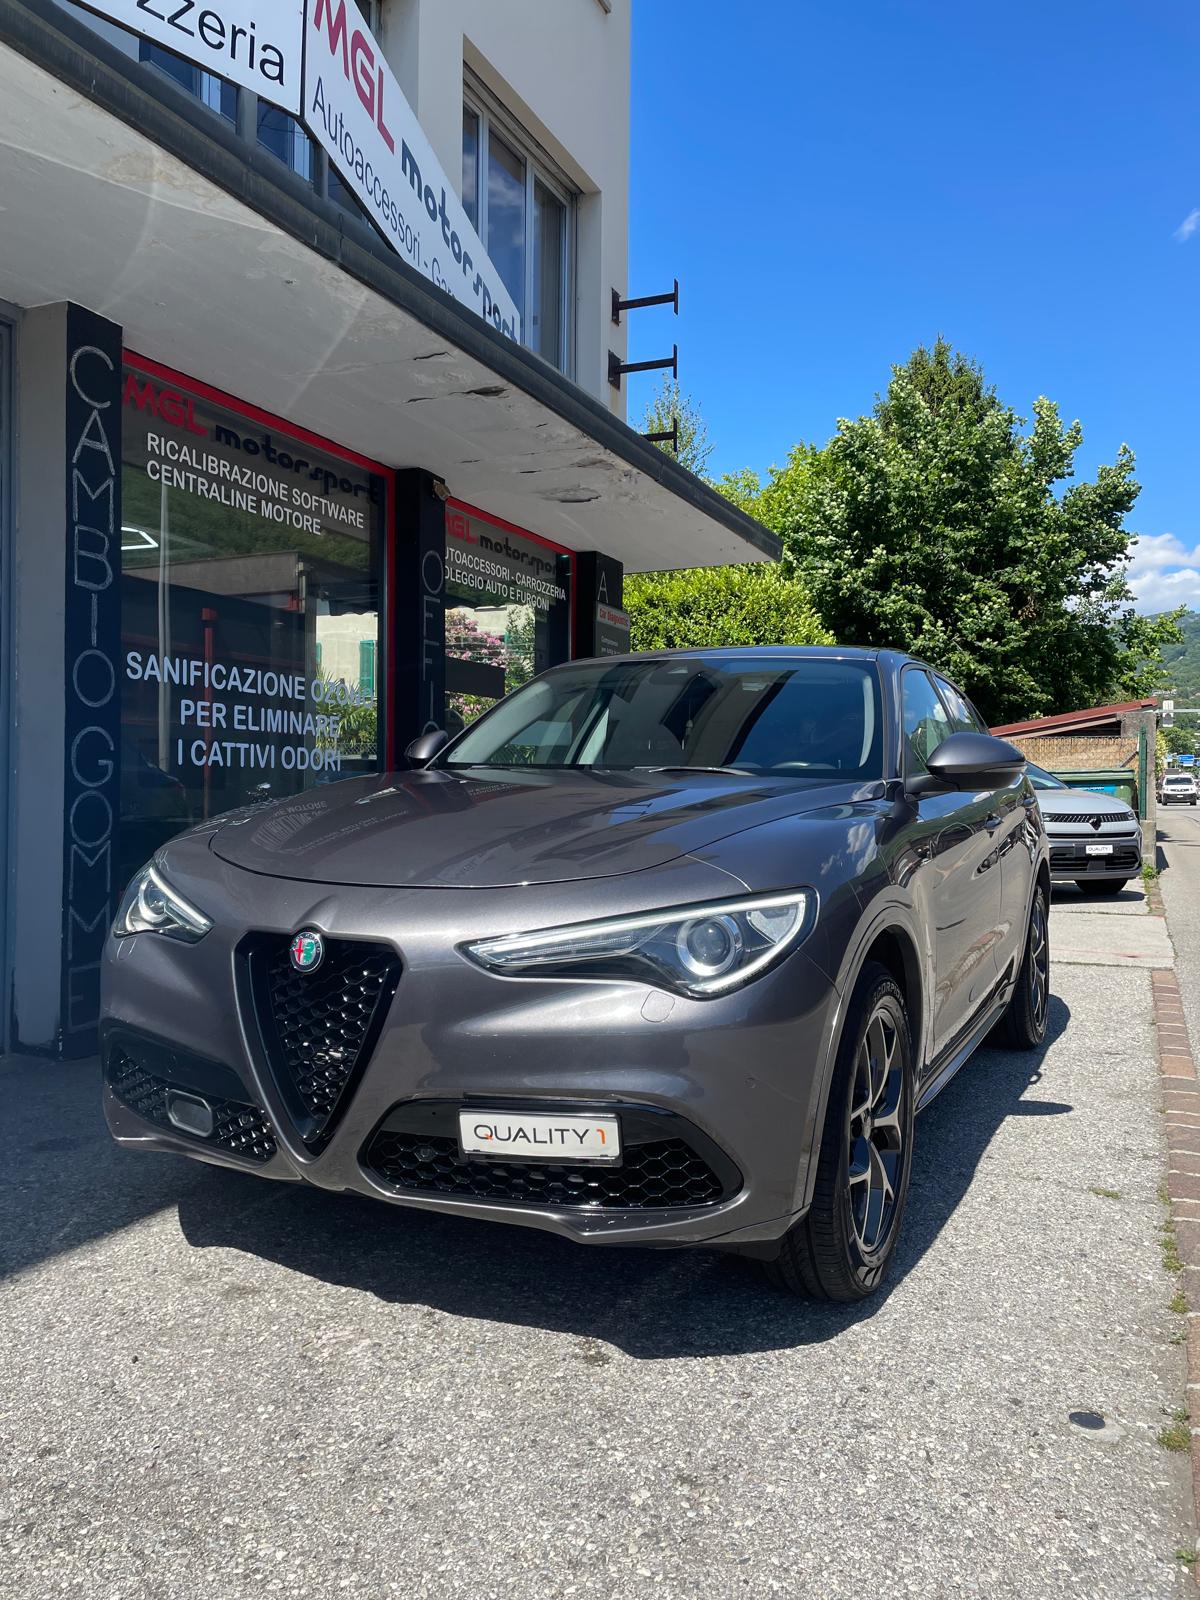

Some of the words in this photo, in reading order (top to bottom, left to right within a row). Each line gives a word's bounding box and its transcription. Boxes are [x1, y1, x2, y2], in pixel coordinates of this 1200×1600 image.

[314, 0, 395, 156] MGL
[313, 75, 420, 267] Autoaccessori
[123, 373, 208, 437] MGL
[146, 459, 257, 515] CENTRALINE
[261, 498, 322, 536] MOTORE
[147, 432, 288, 502] RICALIBRAZIONE
[292, 487, 364, 529] SOFTWARE
[69, 344, 116, 708] CAMBIO
[485, 578, 508, 598] AUTO
[509, 586, 515, 600] E
[516, 588, 550, 612] FURGONI
[516, 571, 566, 601] CARROZZERIA
[126, 651, 306, 701] SANIFICAZIONE
[180, 699, 227, 729] PER
[233, 704, 340, 738] ELIMINARE
[177, 738, 183, 766] I
[190, 739, 275, 769] CATTIVI
[281, 745, 341, 772] ODORI
[68, 725, 115, 1033] GOMME
[473, 1124, 590, 1145] QUALITY
